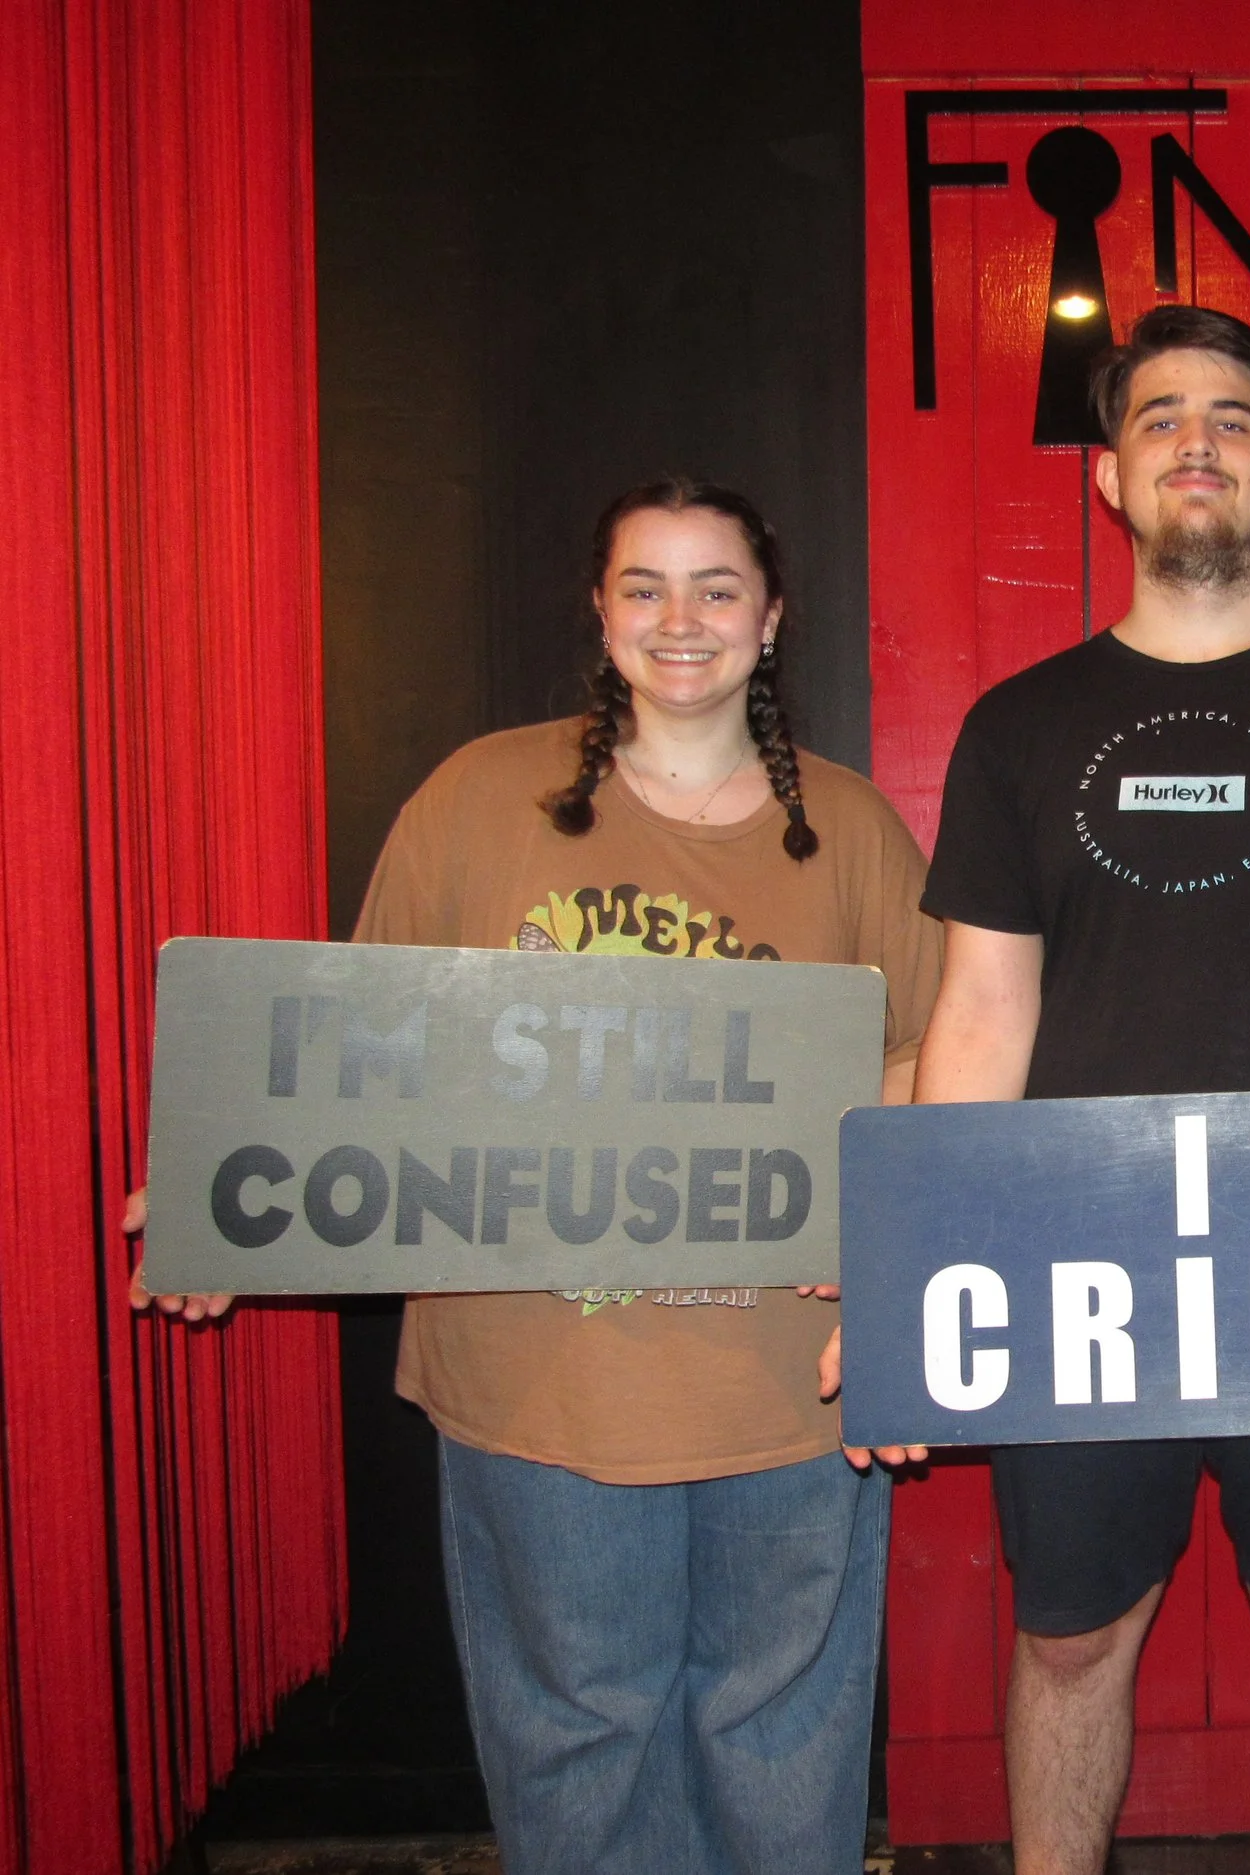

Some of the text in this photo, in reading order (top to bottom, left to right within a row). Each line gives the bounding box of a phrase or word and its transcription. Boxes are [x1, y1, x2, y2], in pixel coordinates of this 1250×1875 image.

[1080, 733, 1124, 790] NORTH
[1134, 784, 1206, 803] Hurley
[268, 996, 774, 1103] I'M STILL
[211, 1144, 812, 1248] CONFUSED
[1174, 1115, 1209, 1236] I
